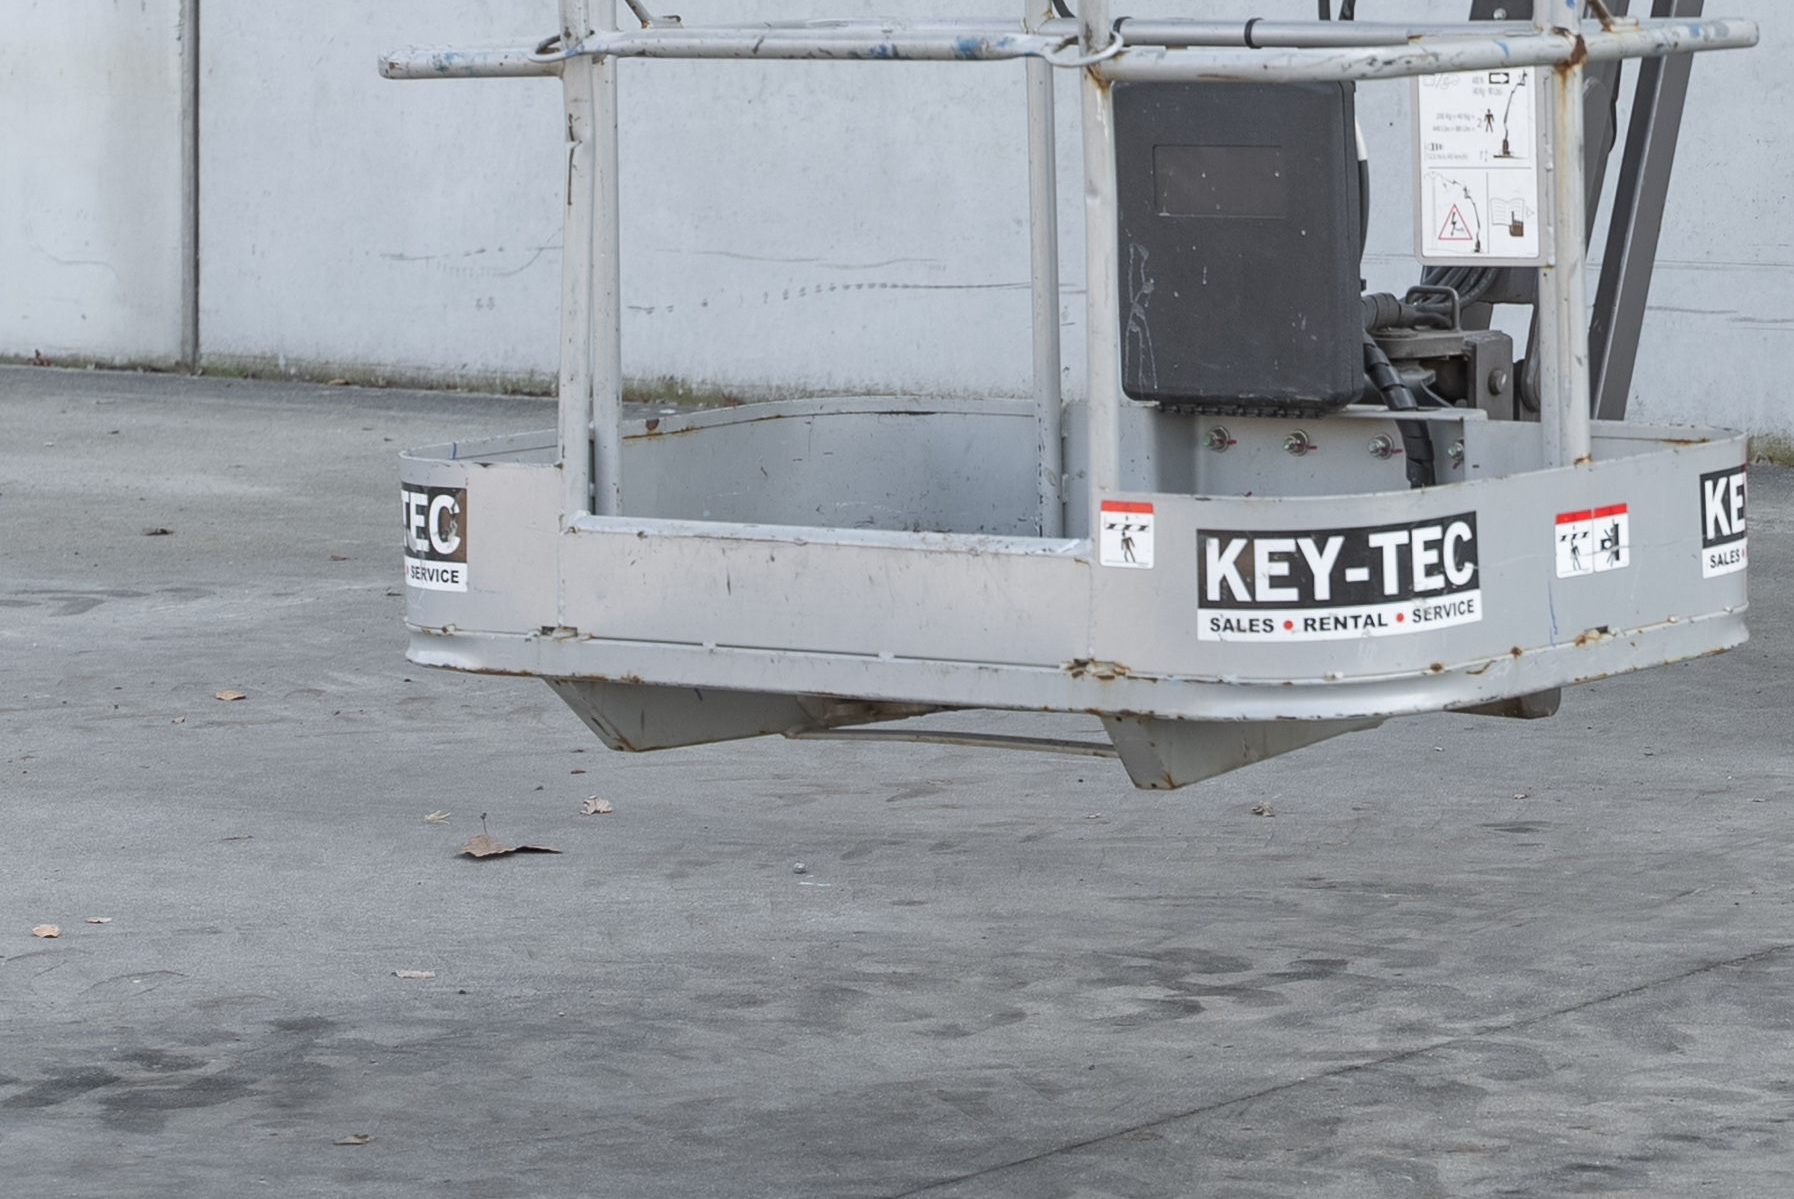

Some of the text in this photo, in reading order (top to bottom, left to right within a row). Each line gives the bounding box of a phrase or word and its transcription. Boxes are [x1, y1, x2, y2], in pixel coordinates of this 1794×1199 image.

[1206, 521, 1474, 602] KEY-TEC
[1709, 549, 1741, 569] SALES
[410, 565, 460, 584] SERVICE
[1210, 599, 1475, 633] SALES RENTAL SERVICE
